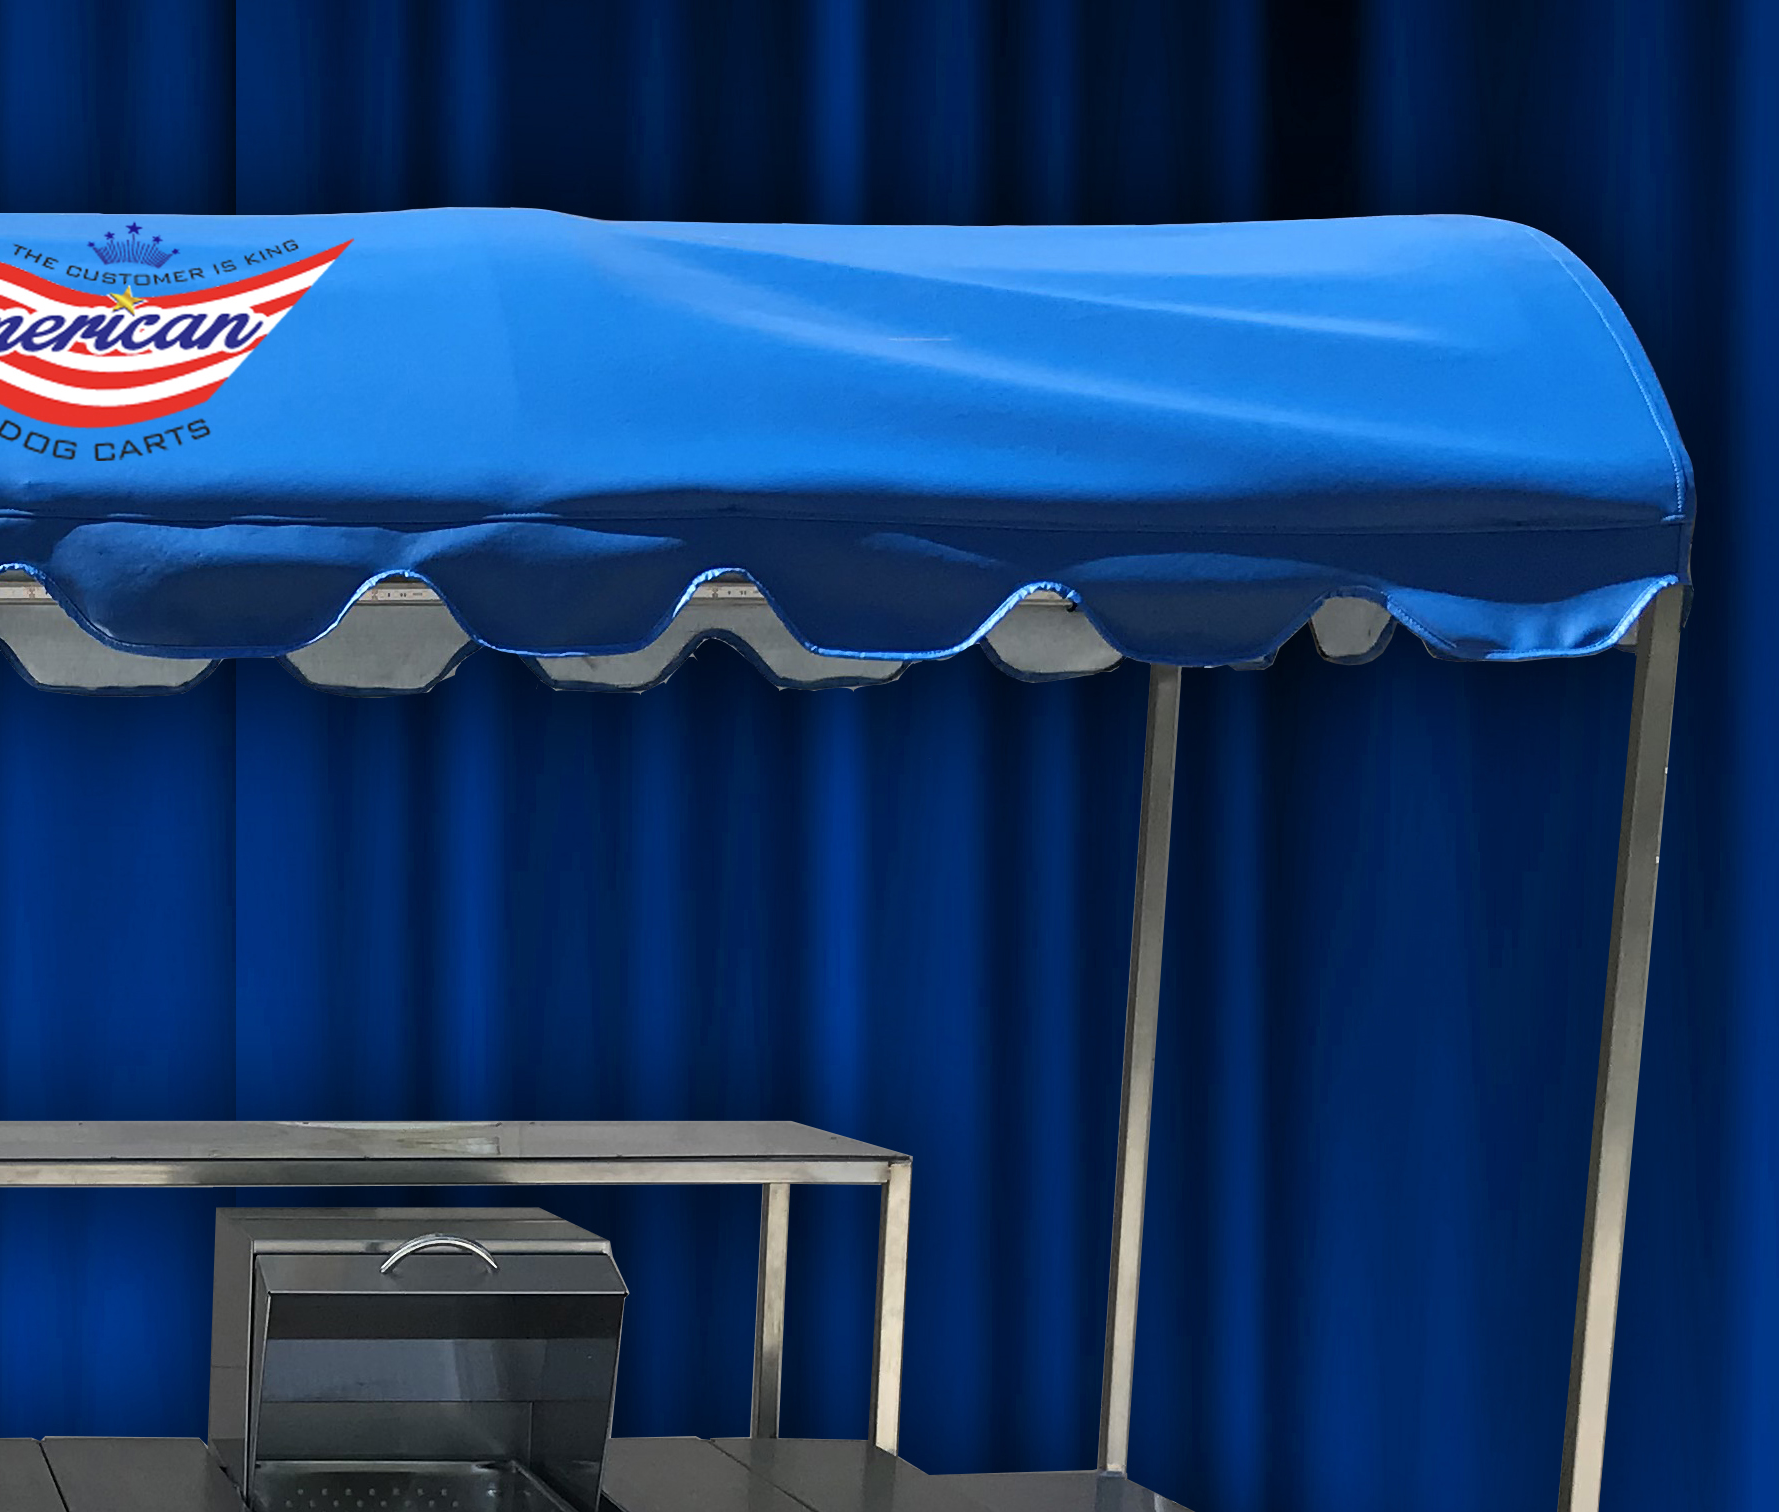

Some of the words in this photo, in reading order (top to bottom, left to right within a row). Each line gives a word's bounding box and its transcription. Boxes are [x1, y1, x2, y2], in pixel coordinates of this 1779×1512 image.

[13, 243, 59, 270] THE
[66, 265, 206, 287] CUSTOMER
[213, 259, 237, 275] IS
[244, 239, 300, 266] KING
[93, 418, 211, 462] CARTS
